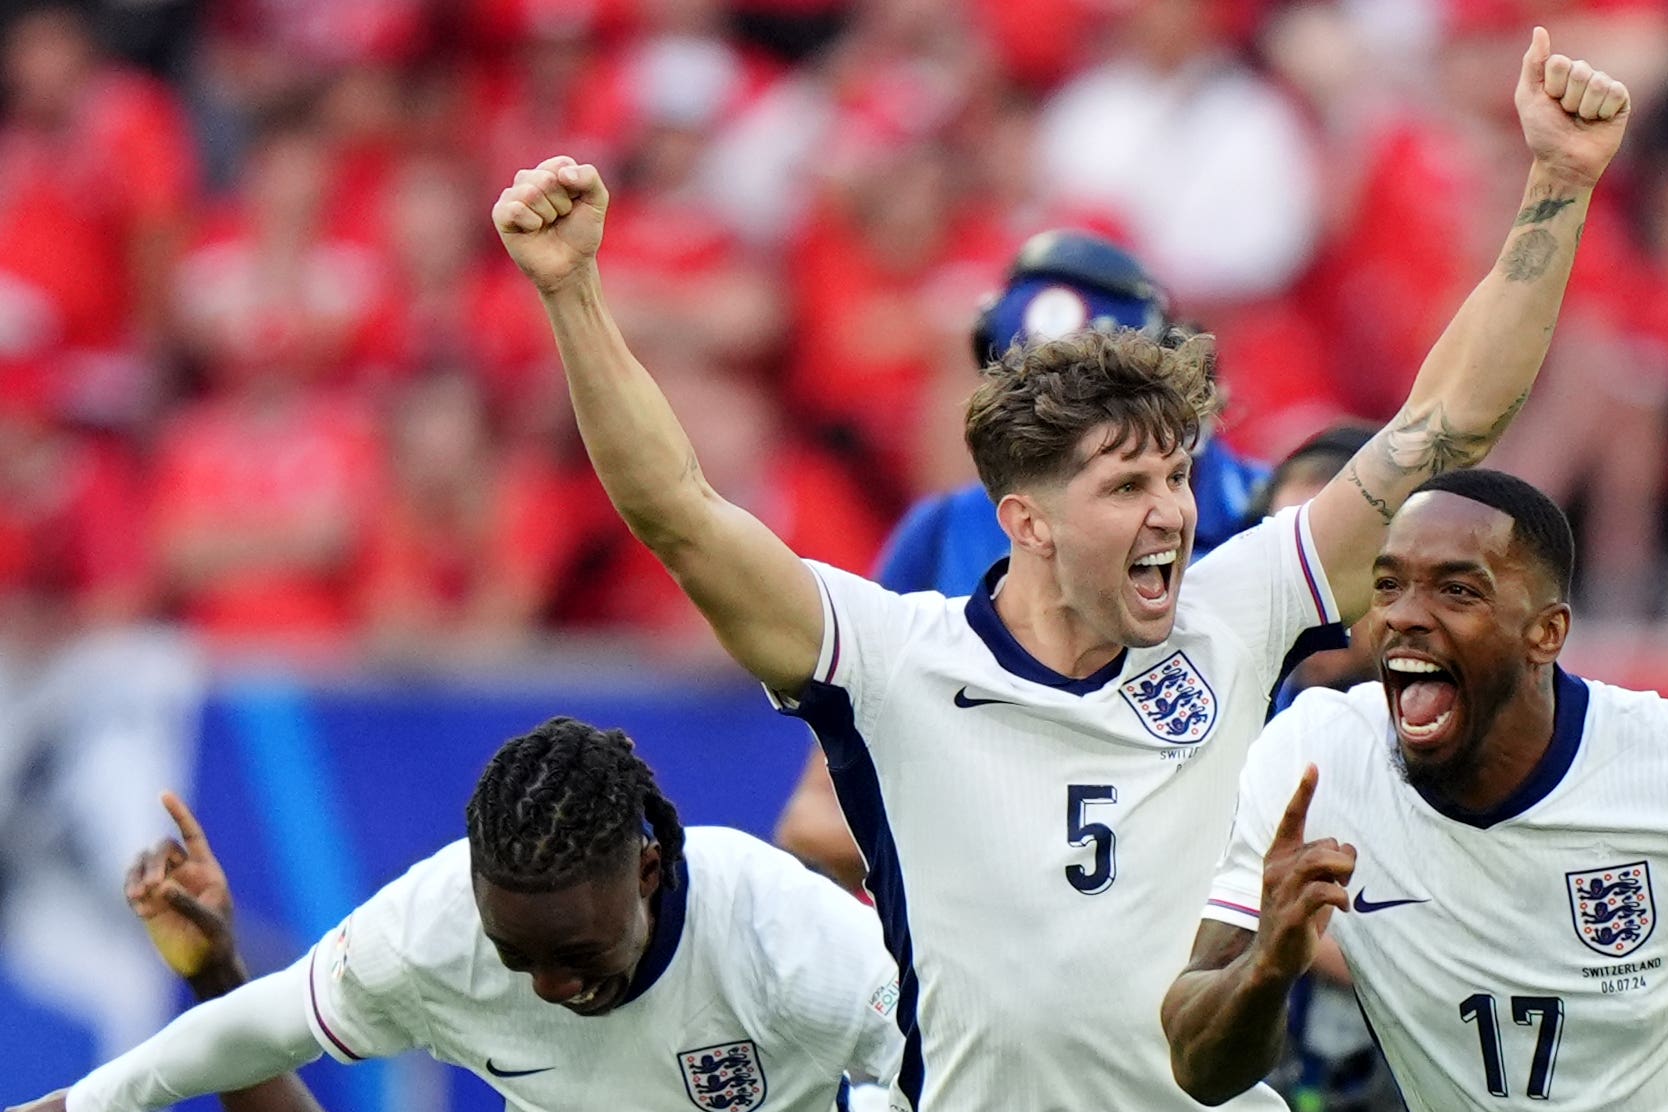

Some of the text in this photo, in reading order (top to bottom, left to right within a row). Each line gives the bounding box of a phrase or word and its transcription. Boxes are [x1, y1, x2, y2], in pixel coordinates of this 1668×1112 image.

[1065, 784, 1118, 895] 5
[1581, 957, 1662, 978] SWITZERLAND
[1601, 975, 1647, 994] 06.07.24
[1459, 993, 1565, 1101] 17
